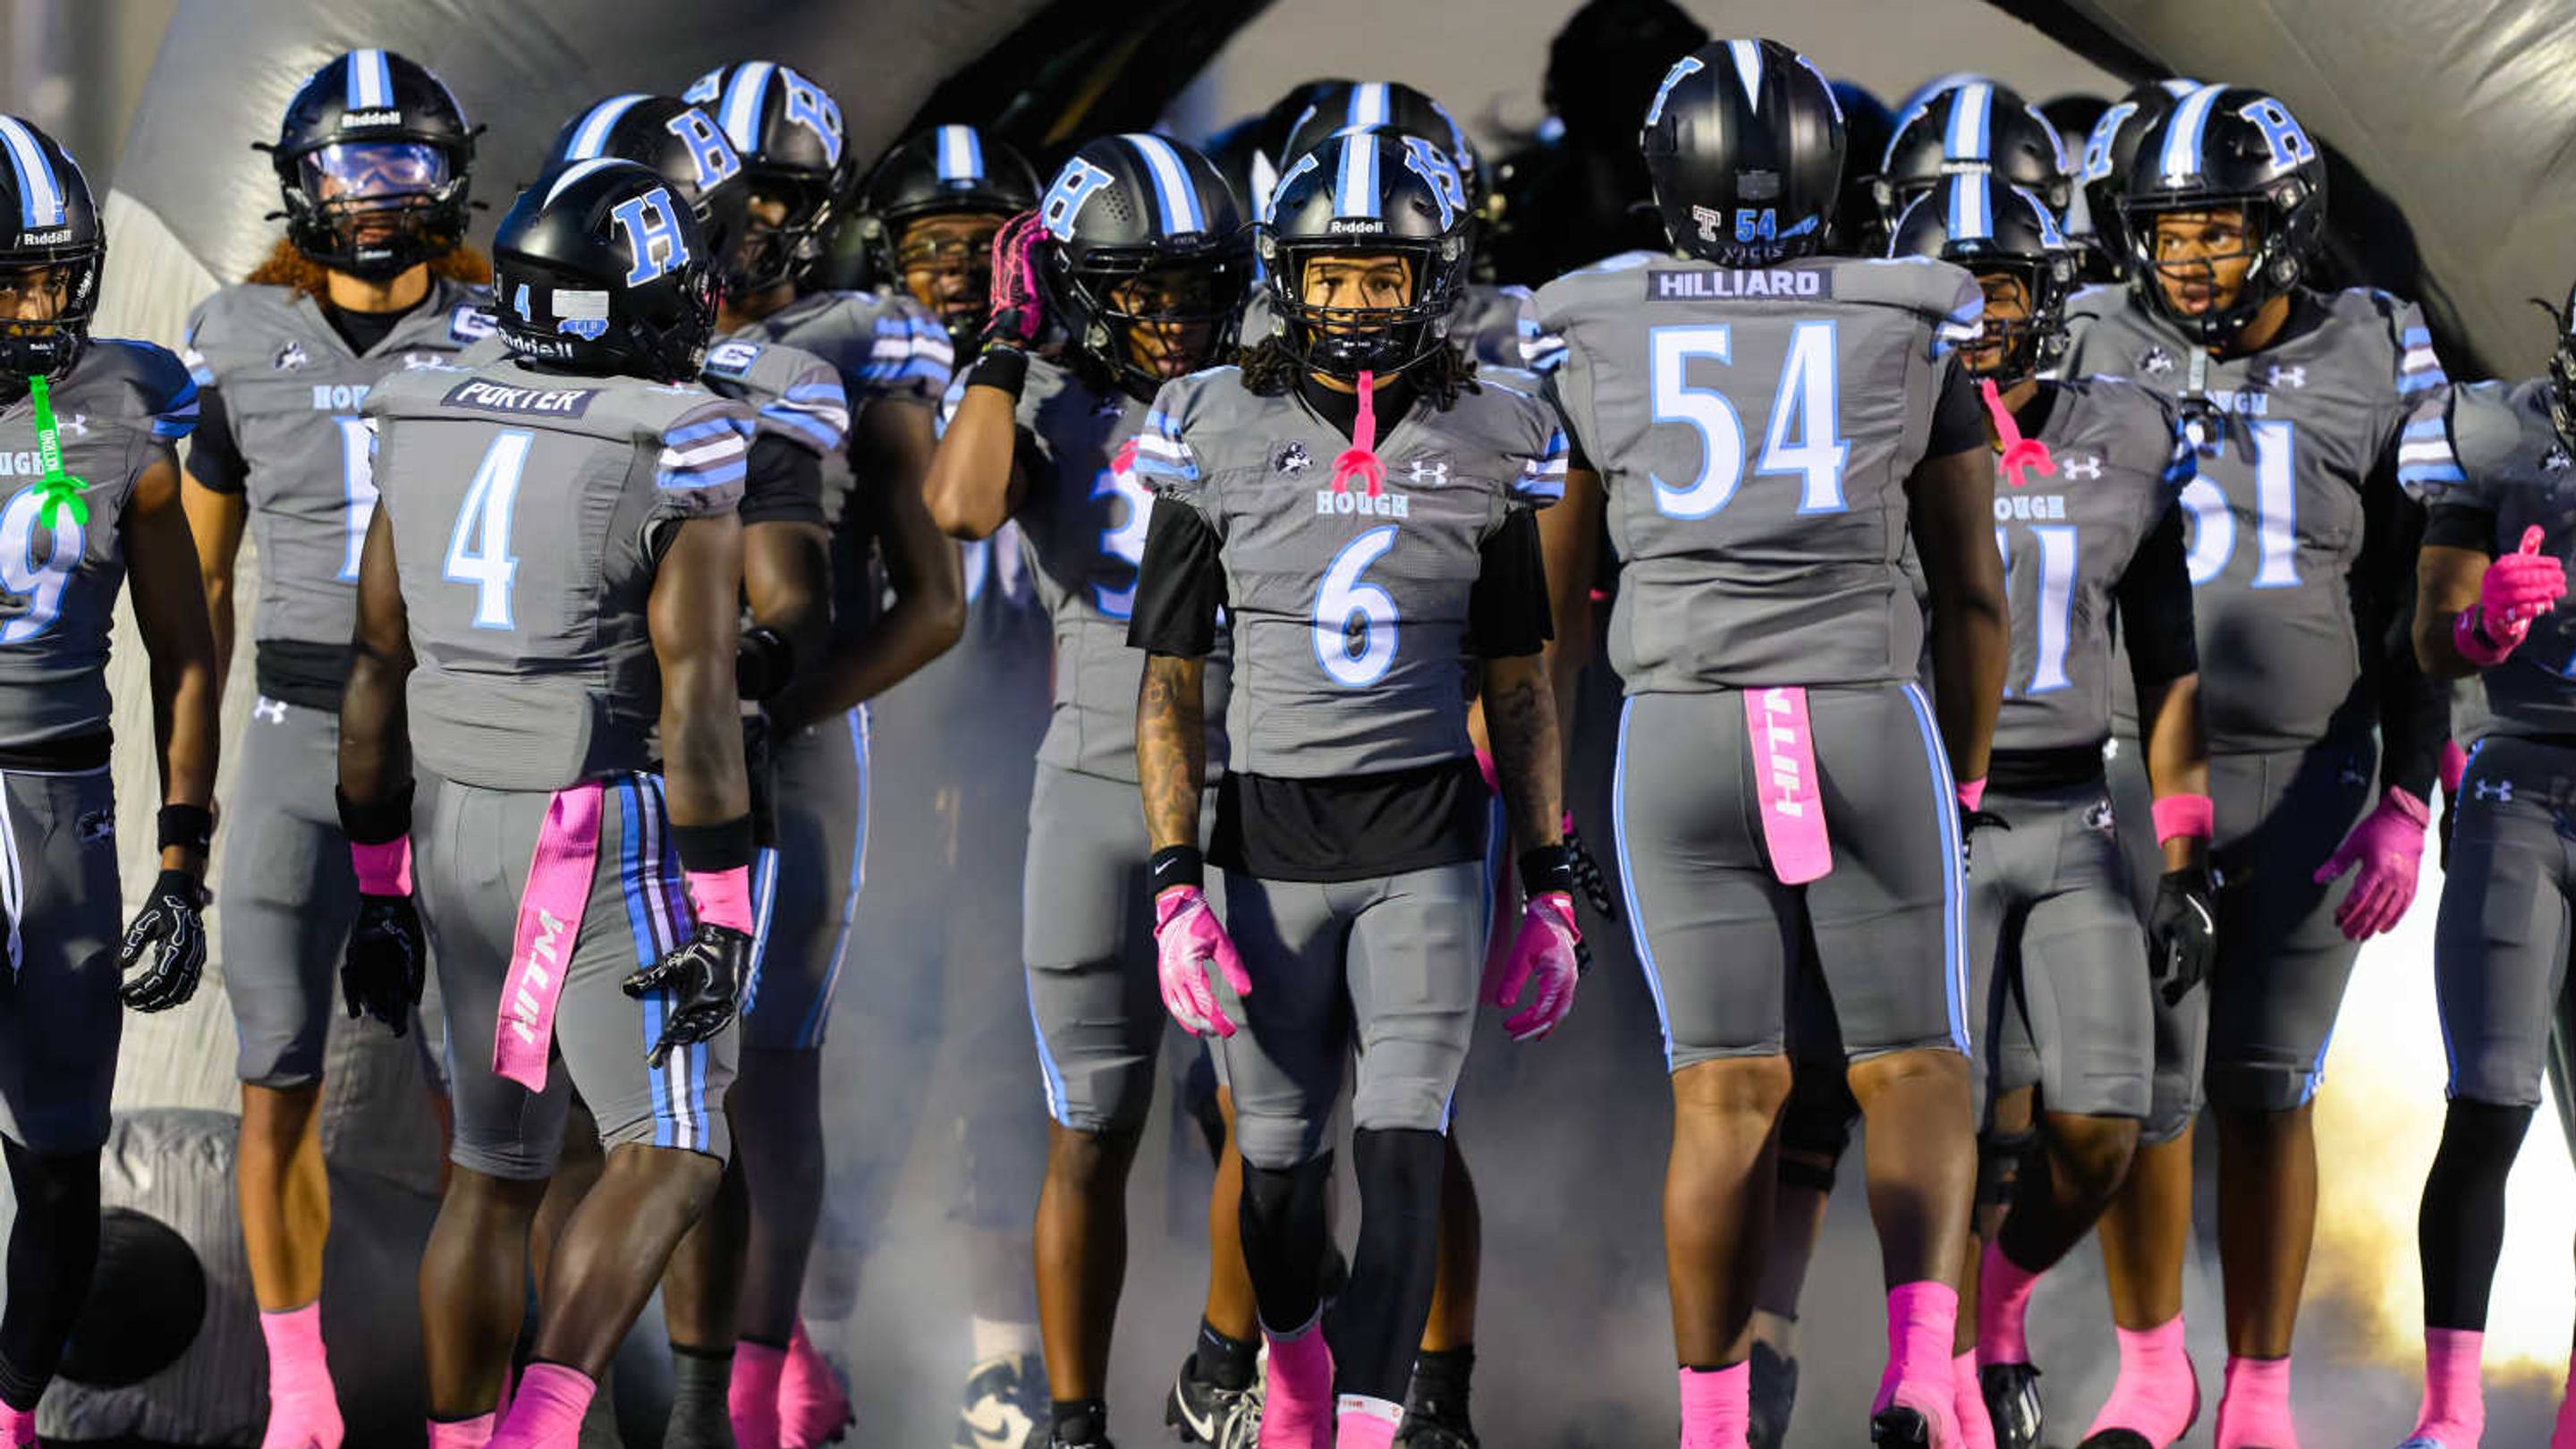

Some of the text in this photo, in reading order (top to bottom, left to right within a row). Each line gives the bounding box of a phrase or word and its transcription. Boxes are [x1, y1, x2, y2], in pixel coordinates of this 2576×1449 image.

[665, 108, 741, 194] H
[2239, 97, 2315, 178] H
[1041, 156, 1115, 243] H
[24, 230, 72, 246] Riddell
[612, 187, 690, 288] H
[1330, 222, 1384, 234] Riddell
[1692, 205, 1721, 242] T
[1735, 208, 1776, 243] 54
[1660, 270, 1820, 297] HILLIARD
[514, 284, 530, 322] 4
[313, 385, 371, 410] HOU
[457, 382, 587, 411] PORTER
[1649, 319, 1852, 521] 54
[0, 452, 43, 476] UGH
[1316, 491, 1409, 518] HOUGH
[1994, 496, 2065, 521] OUGH
[443, 429, 535, 631] 4
[0, 484, 86, 643] 9
[1312, 524, 1400, 687] 6
[512, 908, 564, 1045] HITM
